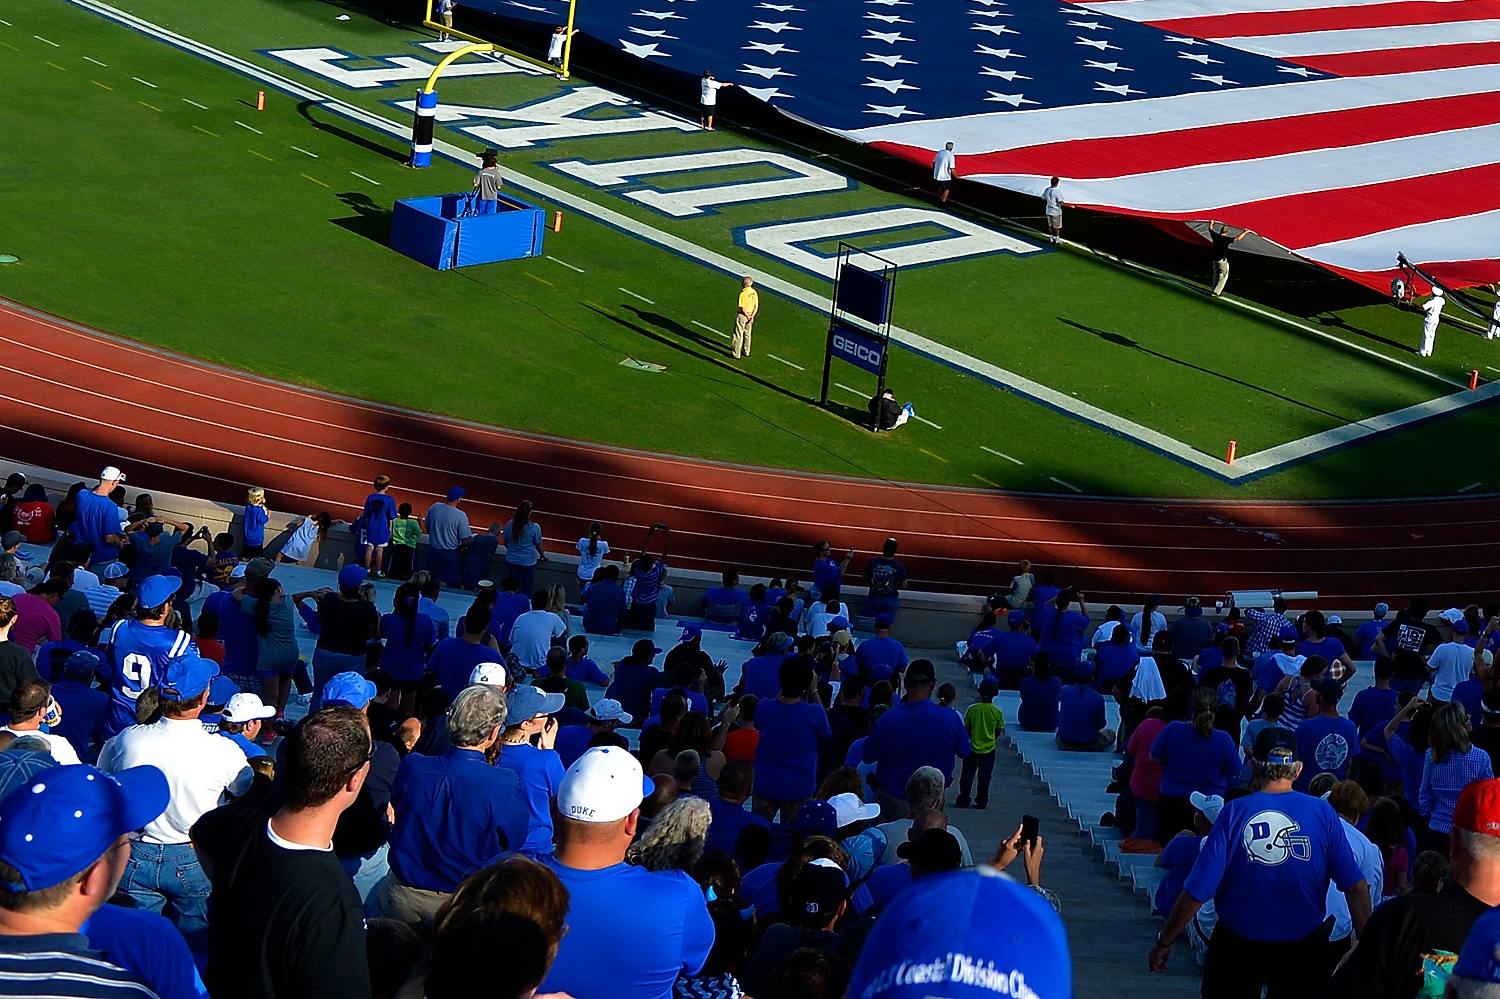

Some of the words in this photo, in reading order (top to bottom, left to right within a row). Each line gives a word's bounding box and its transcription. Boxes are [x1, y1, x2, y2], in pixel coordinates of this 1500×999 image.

[265, 40, 1044, 278] DUKE
[832, 334, 881, 366] GEICO
[122, 652, 152, 700] 9
[571, 805, 596, 818] DUKE
[951, 952, 1010, 995] Division
